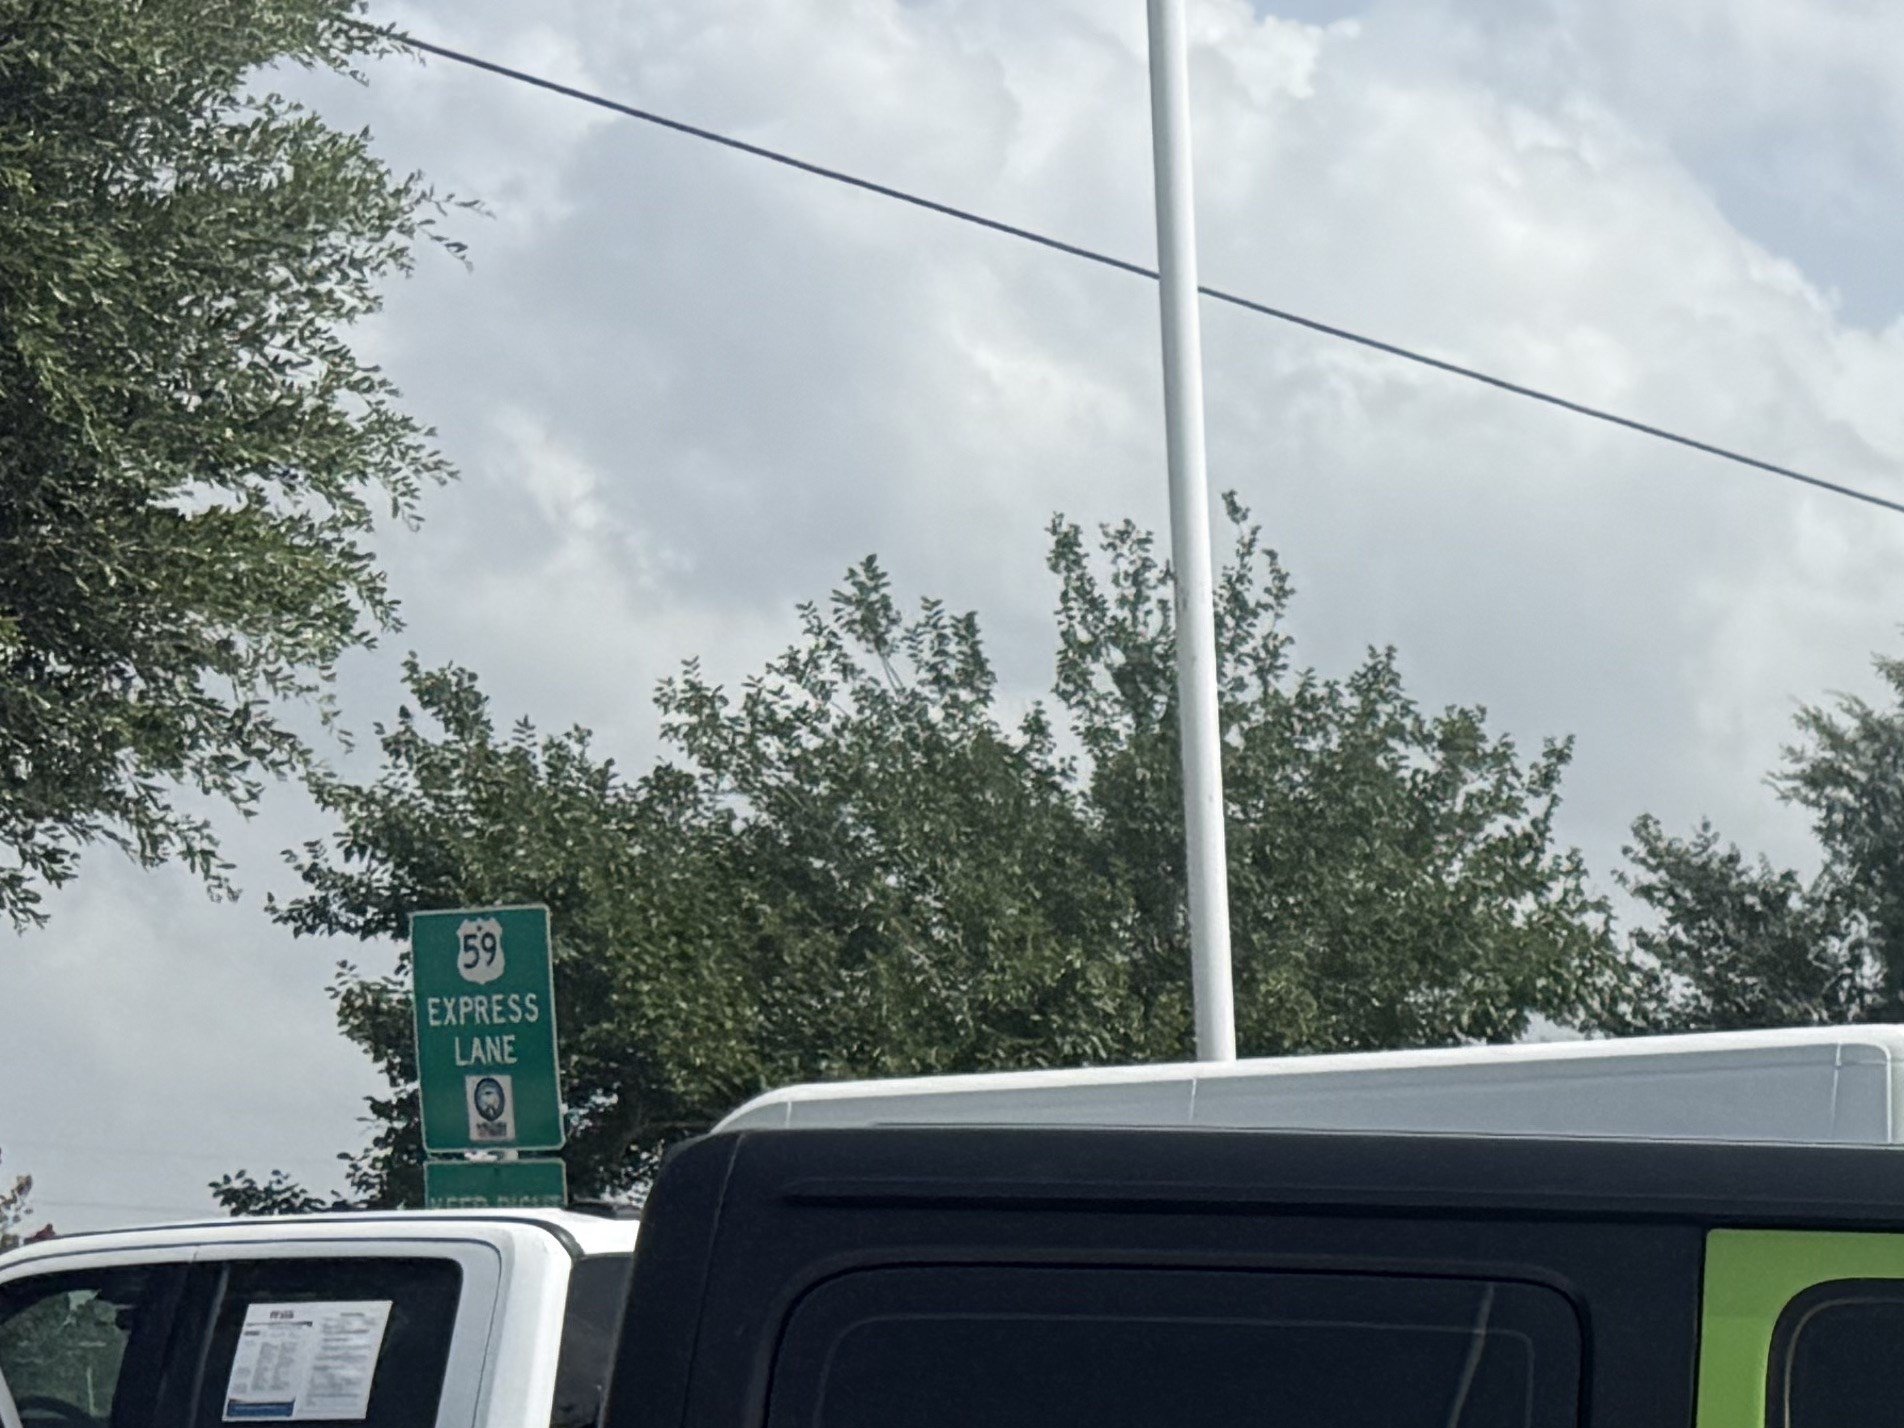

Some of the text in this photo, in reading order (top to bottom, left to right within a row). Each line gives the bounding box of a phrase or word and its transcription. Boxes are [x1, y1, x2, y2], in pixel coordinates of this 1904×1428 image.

[463, 931, 498, 970] 59
[427, 992, 540, 1027] EXPRESS
[454, 1034, 519, 1067] LANE
